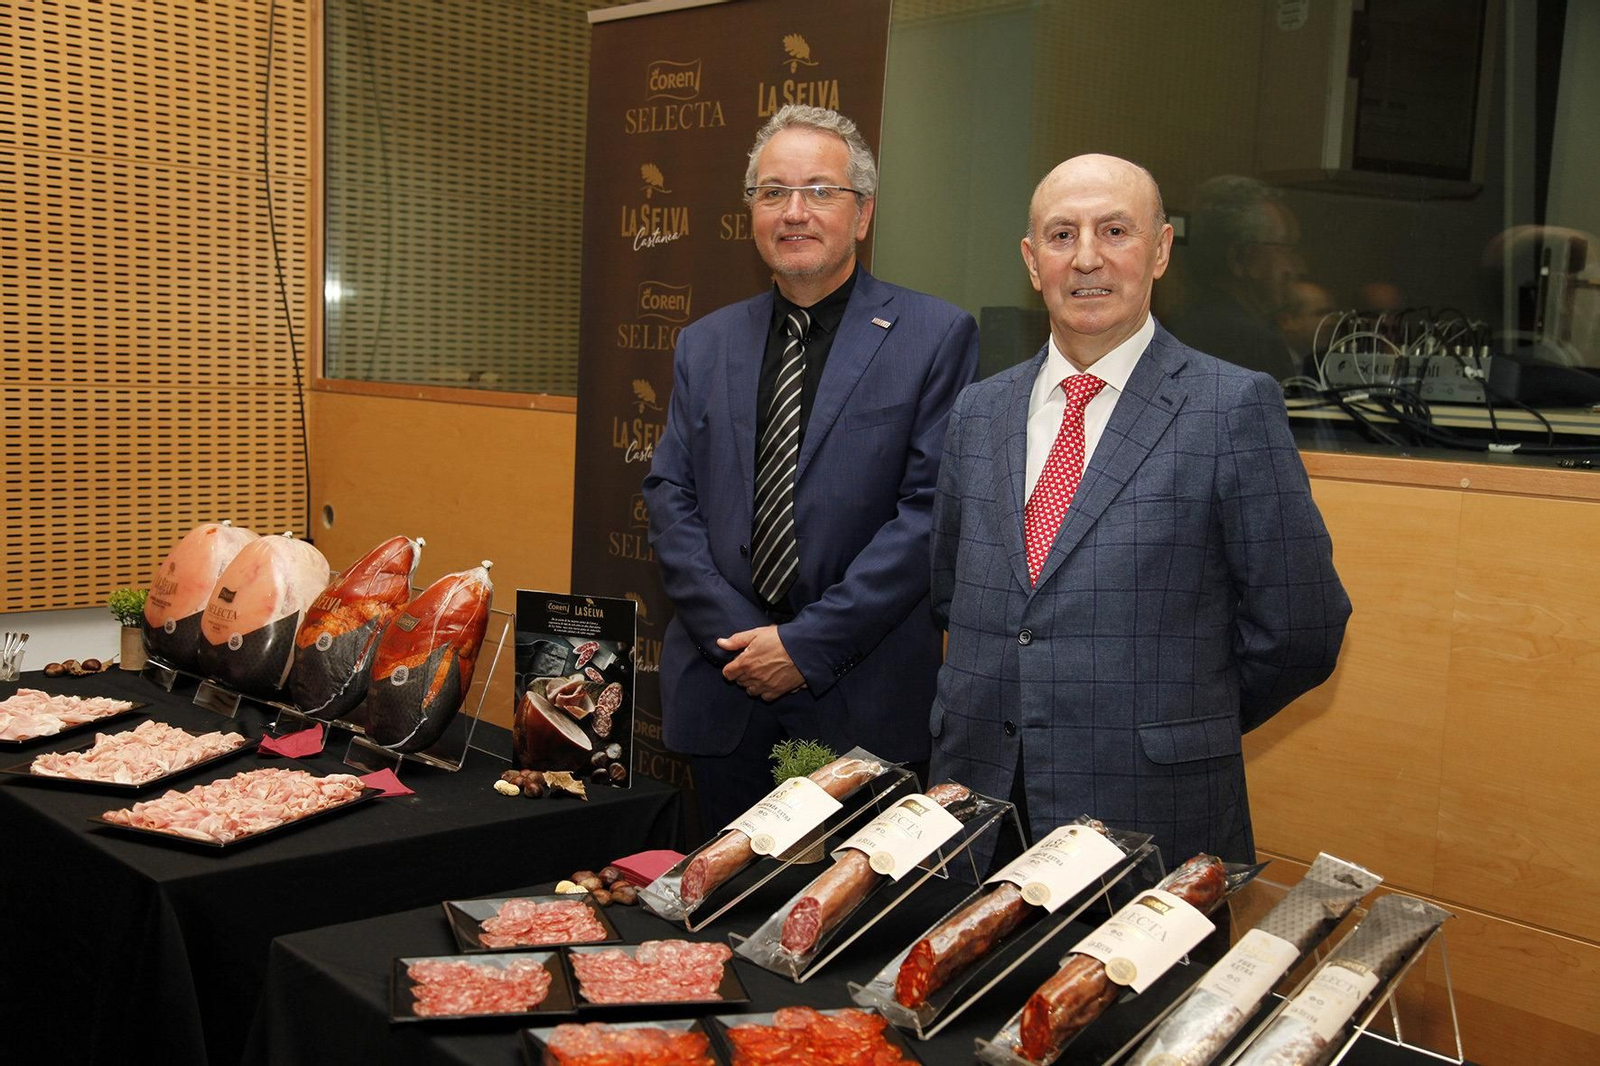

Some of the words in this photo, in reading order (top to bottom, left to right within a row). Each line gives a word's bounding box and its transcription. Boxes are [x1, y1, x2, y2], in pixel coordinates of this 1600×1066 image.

[625, 101, 727, 134] SELECTA
[621, 205, 637, 236] LA
[640, 204, 690, 236] SELVA
[613, 416, 628, 448] LA
